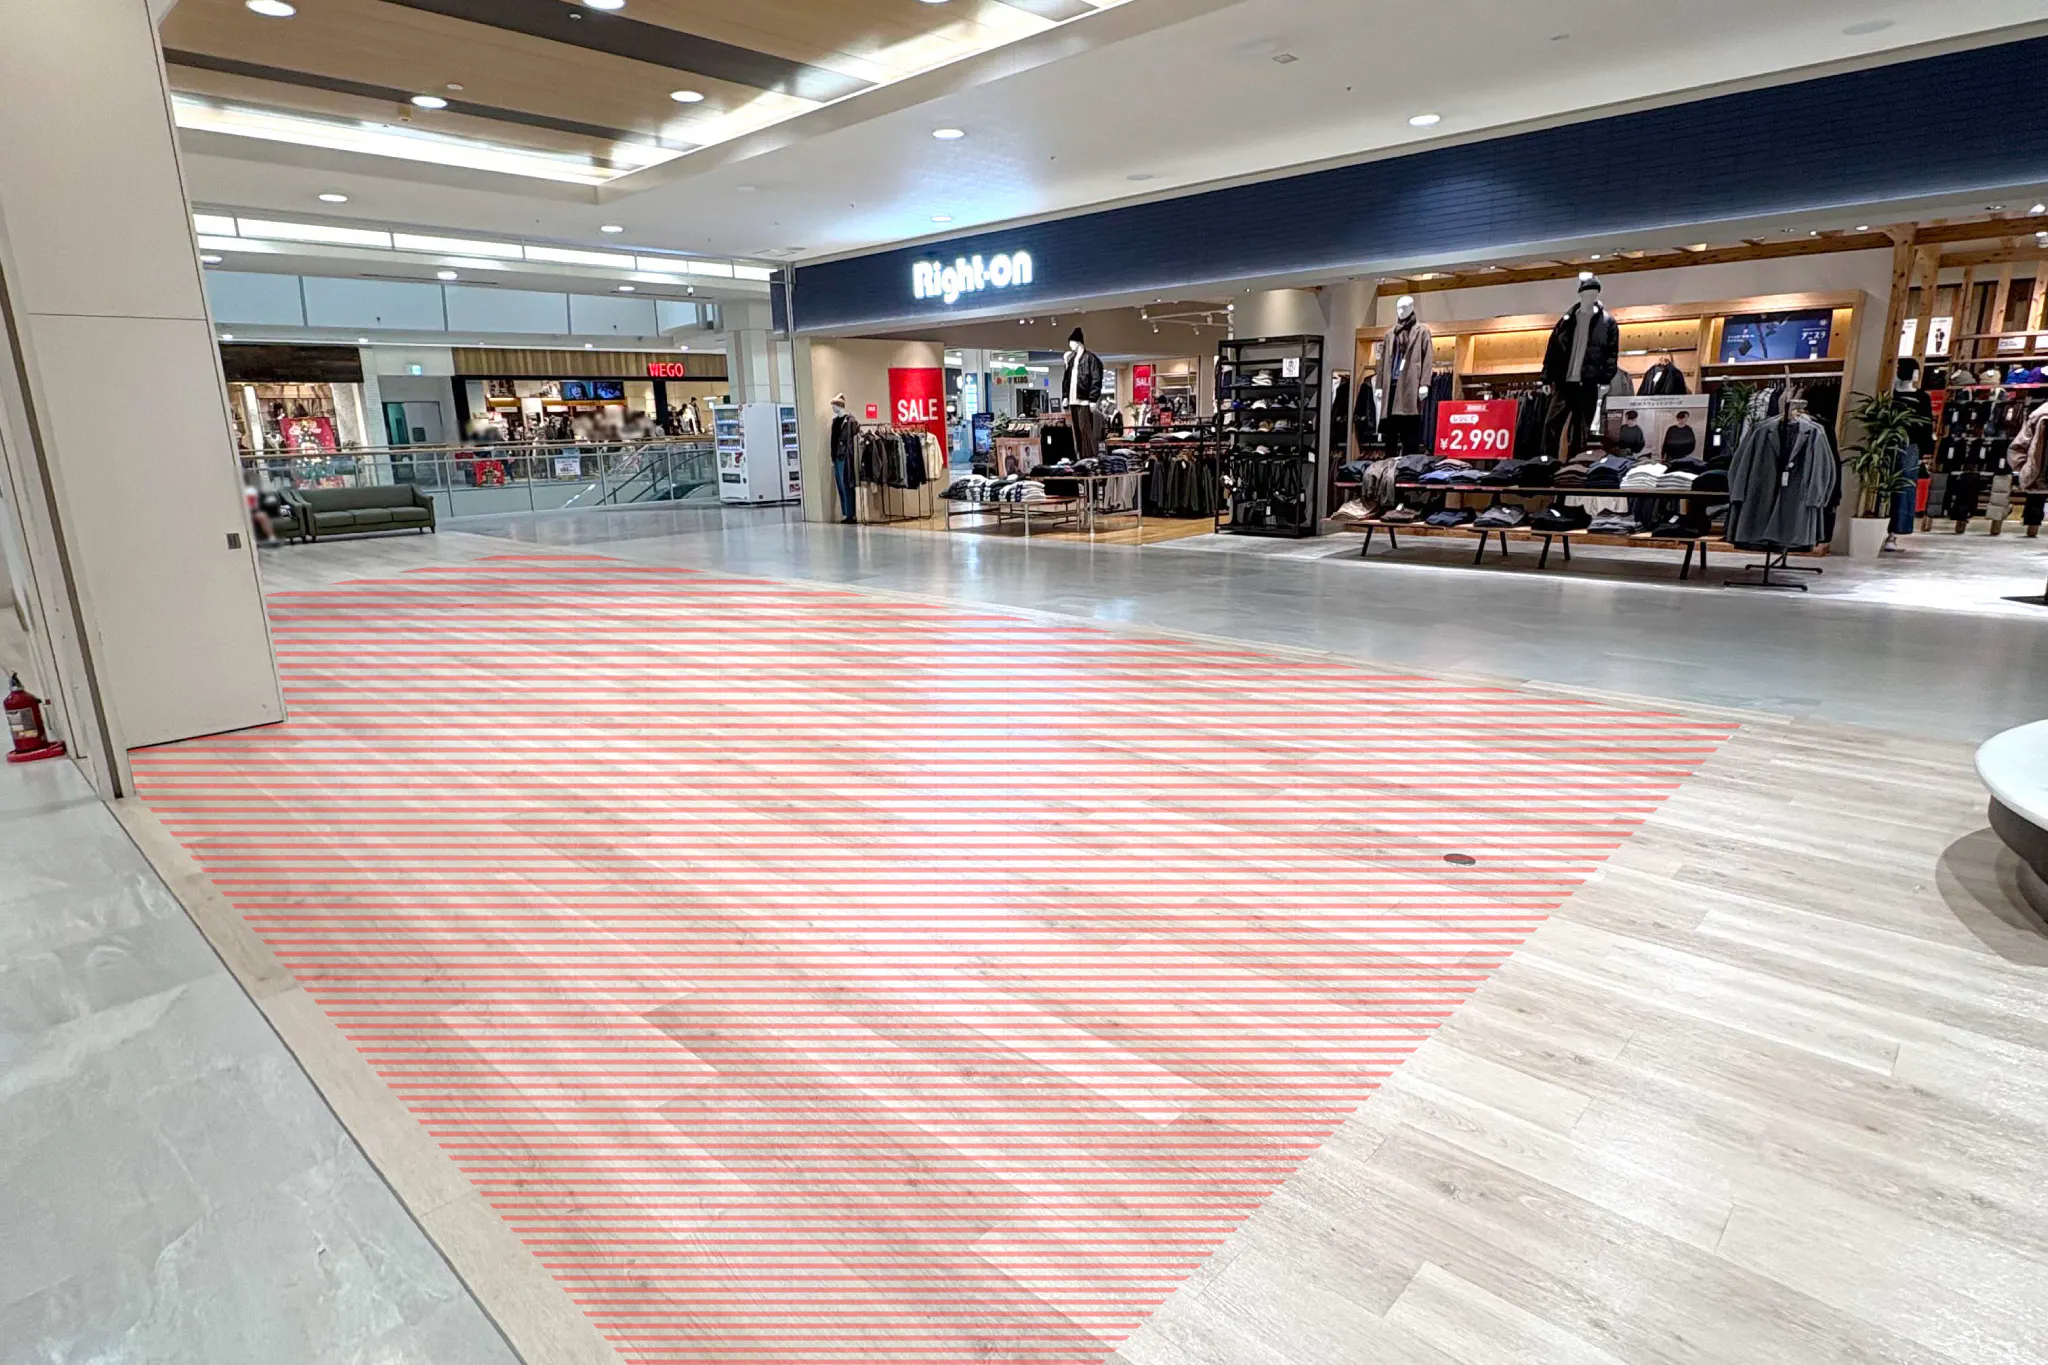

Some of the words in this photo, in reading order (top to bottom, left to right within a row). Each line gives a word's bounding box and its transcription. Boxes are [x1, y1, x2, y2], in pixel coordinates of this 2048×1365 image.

[913, 250, 1033, 304] Right-on
[648, 362, 684, 377] WEGO
[897, 398, 939, 422] SALE
[1440, 429, 1509, 451] ¥2,990
